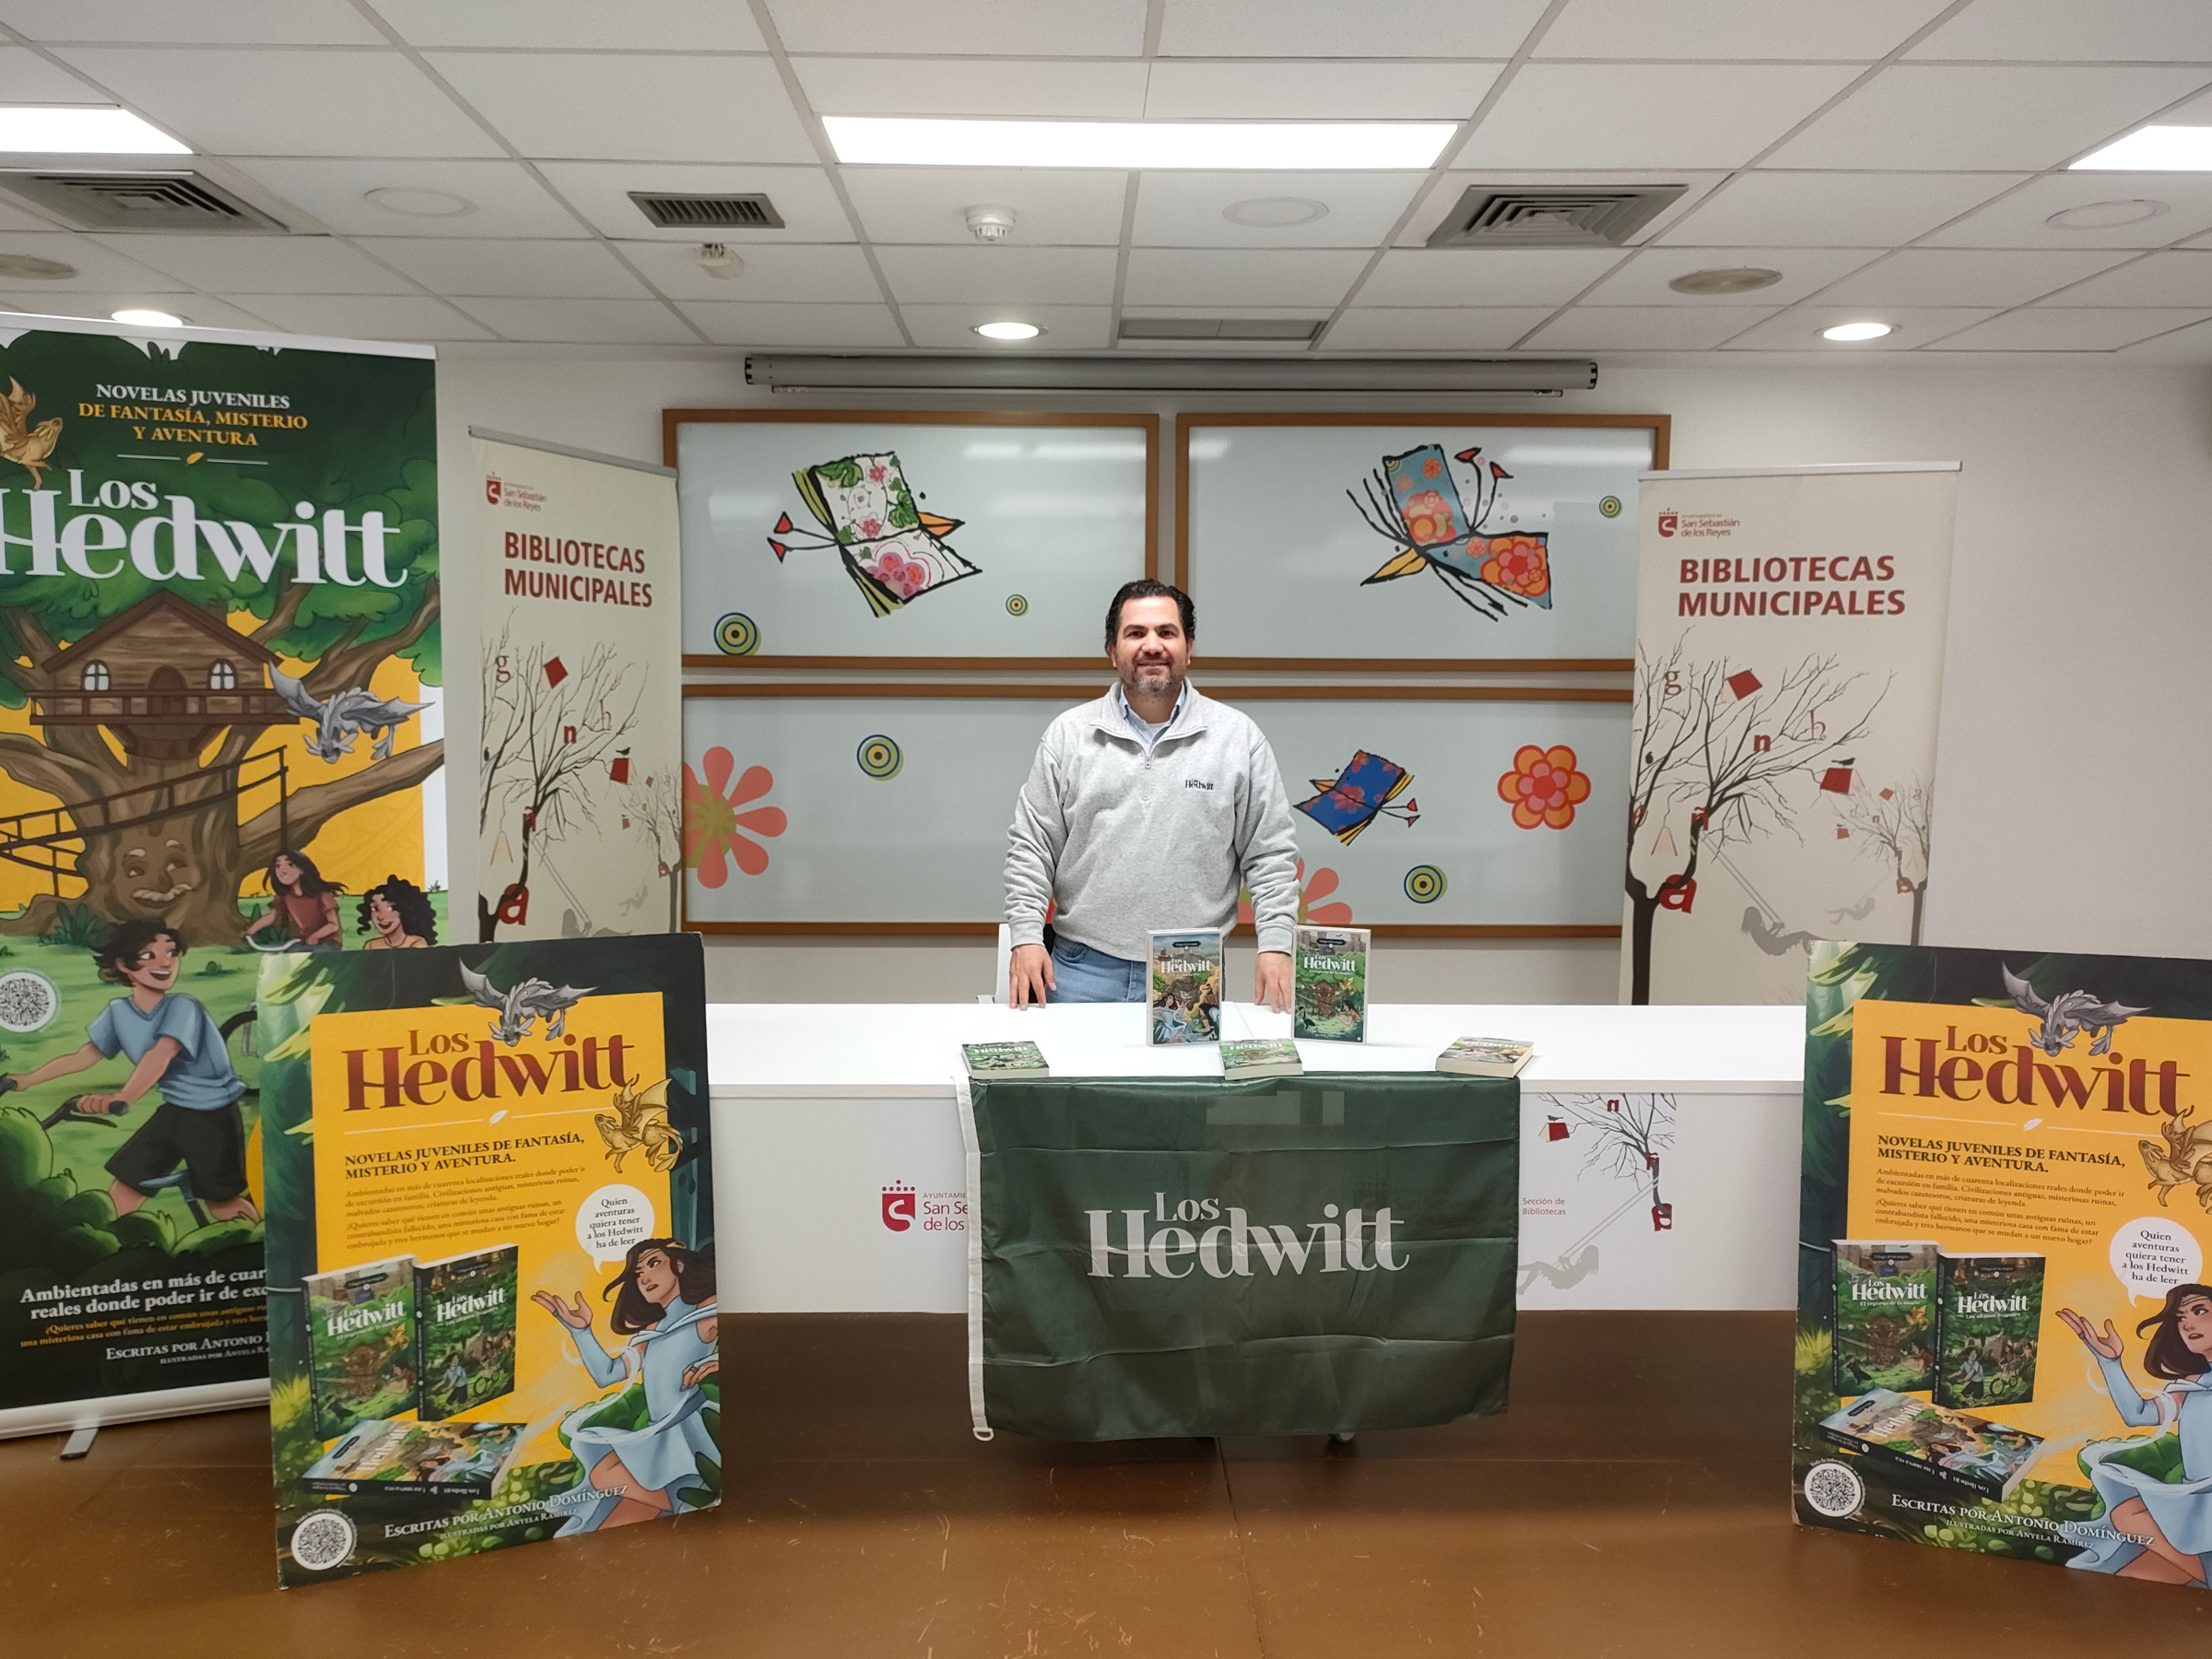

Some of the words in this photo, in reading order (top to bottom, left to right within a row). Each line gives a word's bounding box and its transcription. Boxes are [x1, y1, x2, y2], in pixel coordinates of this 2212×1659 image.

[96, 384, 186, 403] NOVELAS
[190, 390, 289, 409] JUVENILES
[78, 403, 105, 417] DE
[110, 405, 210, 426] FANTASÍA,
[216, 411, 308, 429] MISTERIO
[133, 426, 145, 440] Y
[151, 428, 258, 445] AVENTURA
[1681, 519, 1697, 528] San
[1699, 518, 1740, 527] Sebastián
[1681, 529, 1692, 537] de
[1706, 529, 1731, 538] Reyes
[0, 488, 407, 588] Hedwitt
[505, 532, 645, 573] BIBLIOTECAS
[1679, 555, 1895, 583] BIBLIOTECAS
[505, 569, 653, 607] MUNICIPALES
[1677, 589, 1905, 617] MUNICIPALES
[1161, 959, 1212, 973] Hedwitt
[1303, 957, 1358, 972] Hedwitt
[342, 1033, 640, 1112] Hedwitt
[1879, 1035, 2194, 1117] Hedwitt
[345, 1150, 411, 1166] NOVELAS
[416, 1142, 489, 1160] JUVENILES
[493, 1140, 511, 1151] DE
[515, 1131, 584, 1148] FANTASÍA,
[1877, 1135, 1942, 1150] NOVELAS
[1945, 1141, 2021, 1157] JUVENILES
[2025, 1148, 2044, 1159] DE
[2048, 1150, 2125, 1168] FANTASÍA,
[1877, 1148, 1947, 1163] MISTERIO
[1951, 1155, 1959, 1164] Y
[1963, 1156, 2049, 1172] AVENTURA.
[346, 1163, 417, 1179] MISTERIO
[421, 1161, 429, 1171] Y
[434, 1153, 516, 1170] AVENTURA.
[1877, 1167, 1924, 1179] Ambientadas
[1936, 1173, 1950, 1182] más
[1951, 1174, 1959, 1182] de
[1994, 1178, 2044, 1190] localizaciones
[2046, 1183, 2066, 1192] reales
[2068, 1184, 2092, 1194] donde
[2094, 1188, 2116, 1197] poder
[2118, 1189, 2124, 1197] ir
[1877, 1176, 1884, 1184] de
[1886, 1179, 1920, 1188] excursión
[1932, 1182, 1959, 1192] familia.
[1960, 1184, 2011, 1196] Civilizaciones
[2013, 1190, 2046, 1201] antiguas,
[2048, 1193, 2088, 1204] misteriosas
[2091, 1196, 2117, 1207] ruinas,
[601, 1198, 628, 1208] Quien
[924, 1201, 950, 1215] San
[954, 1201, 968, 1215] Se
[1523, 1197, 1553, 1206] Sección
[1555, 1197, 1565, 1206] de
[1877, 1186, 1909, 1196] malvados
[1910, 1192, 1952, 1202] cazatesoros,
[1954, 1194, 1985, 1203] criaturas
[1987, 1195, 1995, 1204] de
[1997, 1196, 2028, 1207] leyenda.
[594, 1207, 635, 1218] aventuras
[924, 1217, 942, 1230] de
[945, 1217, 965, 1230] los
[1523, 1207, 1566, 1216] Bibliotecas
[1876, 1208, 1928, 1219] contrabandista
[1930, 1212, 1962, 1224] fallecido,
[1980, 1218, 2017, 1228] misteriosa
[2050, 1223, 2068, 1232] fama
[2070, 1225, 2078, 1233] de
[1908, 1201, 1926, 1209] saber
[1928, 1203, 1942, 1212] qué
[1944, 1204, 1966, 1213] tienen
[1978, 1208, 2004, 1217] común
[2025, 1213, 2056, 1223] antiguas
[2058, 1216, 2083, 1226] ruinas,
[589, 1220, 617, 1230] quiera
[618, 1218, 641, 1226] tener
[594, 1229, 606, 1239] los
[607, 1226, 643, 1237] Hedwitt
[2140, 1230, 2171, 1241] Quien
[596, 1241, 606, 1249] ha
[608, 1239, 618, 1248] de
[620, 1237, 636, 1246] leer
[1084, 1203, 1410, 1279] Hedwitt
[2132, 1241, 2180, 1253] aventuras
[2125, 1251, 2157, 1262] quiera
[2159, 1255, 2186, 1265] tener
[2130, 1261, 2144, 1271] los
[2146, 1263, 2189, 1276] Hedwitt
[20, 1281, 138, 1303] Ambientadas
[142, 1281, 162, 1291] en
[168, 1274, 201, 1288] más
[205, 1272, 225, 1285] de
[2132, 1272, 2144, 1281] ha
[2146, 1274, 2158, 1283] de
[2160, 1275, 2179, 1285] leer
[31, 1304, 81, 1320] reales
[85, 1297, 140, 1313] donde
[145, 1291, 194, 1311] poder
[199, 1288, 215, 1301] ir
[218, 1286, 238, 1299] de
[1852, 1283, 1928, 1300] Hedwitt
[437, 1288, 506, 1323] Hedwitt
[1958, 1295, 2030, 1313] Hedwitt
[327, 1300, 406, 1336] Hedwitt
[106, 1345, 169, 1360] ESCRITAS
[172, 1342, 197, 1353] POR
[201, 1335, 263, 1349] ANTONIO
[384, 1516, 449, 1539] ESCRITAS
[453, 1513, 479, 1526] POR
[482, 1499, 546, 1522] ANTONIO
[548, 1484, 629, 1508] DOMÍNGUEZ
[1891, 1494, 1957, 1516] ESCRITAS
[1959, 1507, 1987, 1521] POR
[1991, 1509, 2060, 1531] ANTONIO
[2063, 1520, 2154, 1547] DOMÍNGUEZ
[1946, 1519, 1996, 1533] ILUSTRADAS
[1998, 1527, 2015, 1536] POR
[2017, 1529, 2051, 1543] ANYELA
